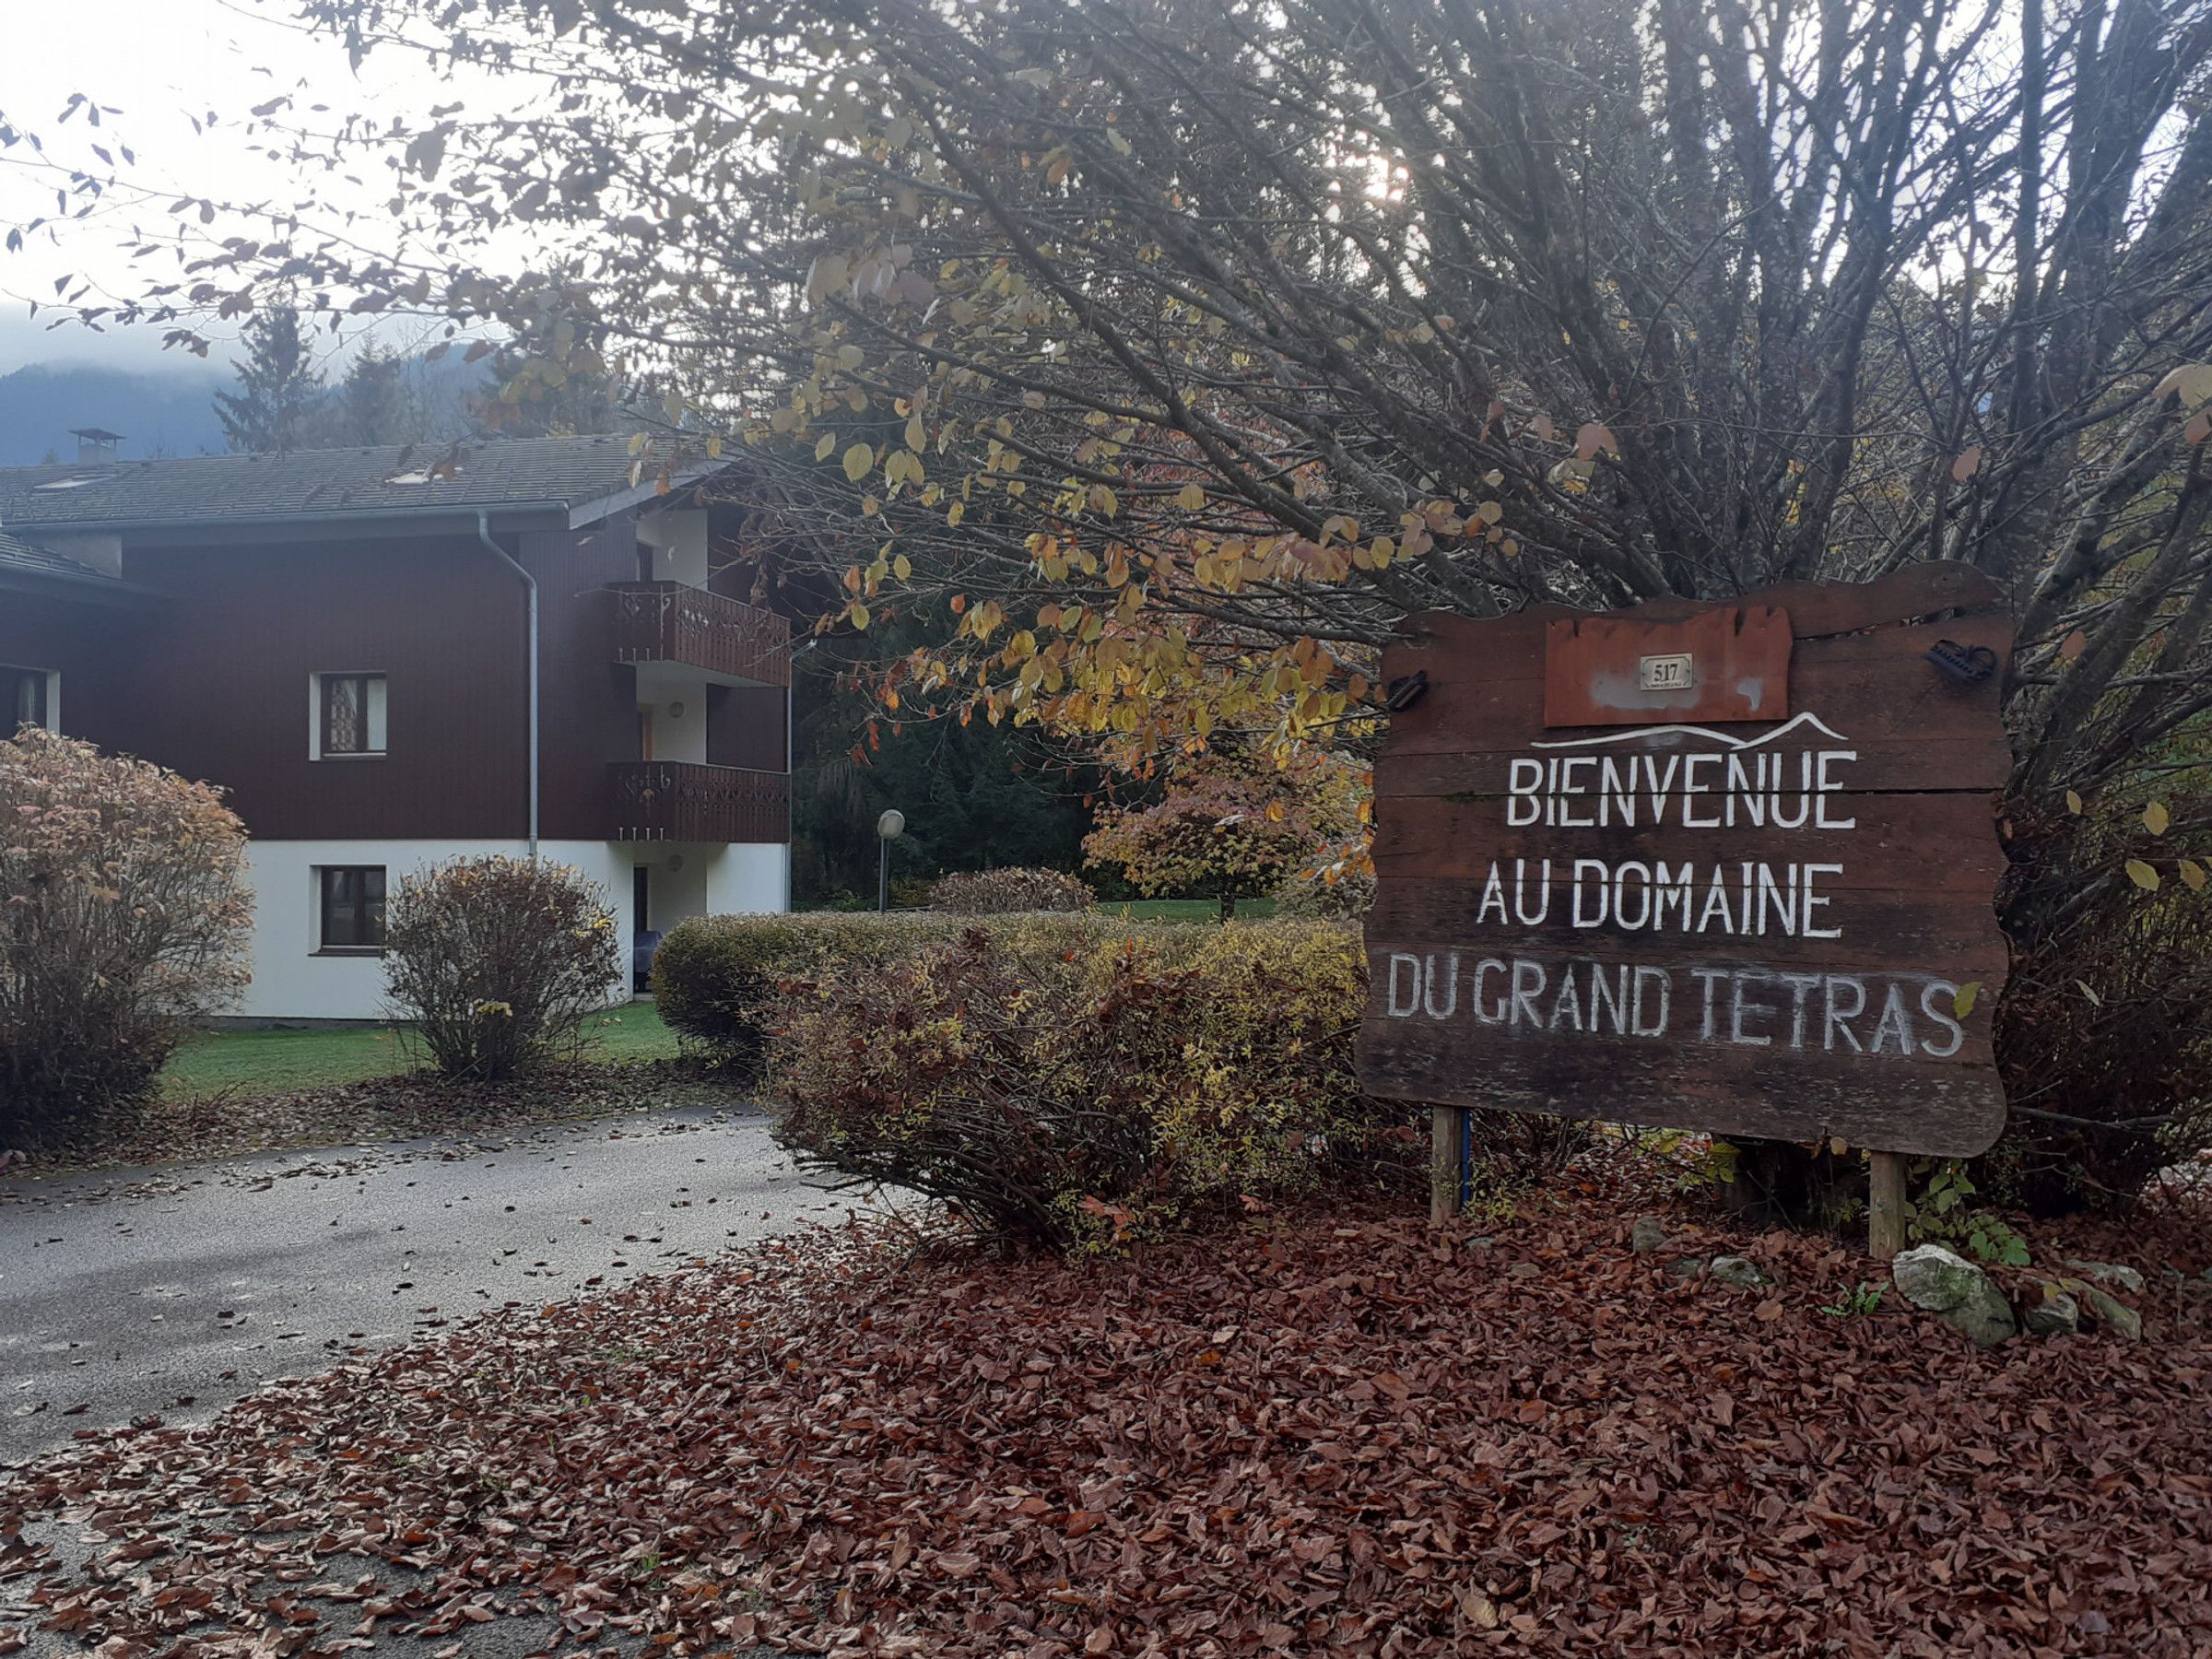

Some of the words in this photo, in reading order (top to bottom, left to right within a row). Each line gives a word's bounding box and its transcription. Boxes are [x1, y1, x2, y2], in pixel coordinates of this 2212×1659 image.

[1653, 664, 1678, 682] 517
[1507, 751, 1857, 829] BIENVENUE
[1477, 859, 1550, 925] AU
[1572, 859, 1843, 938] DOMAINE
[1388, 952, 1458, 1019] DU
[1475, 959, 1671, 1037] GRAND
[1690, 968, 1964, 1057] TETRAS
